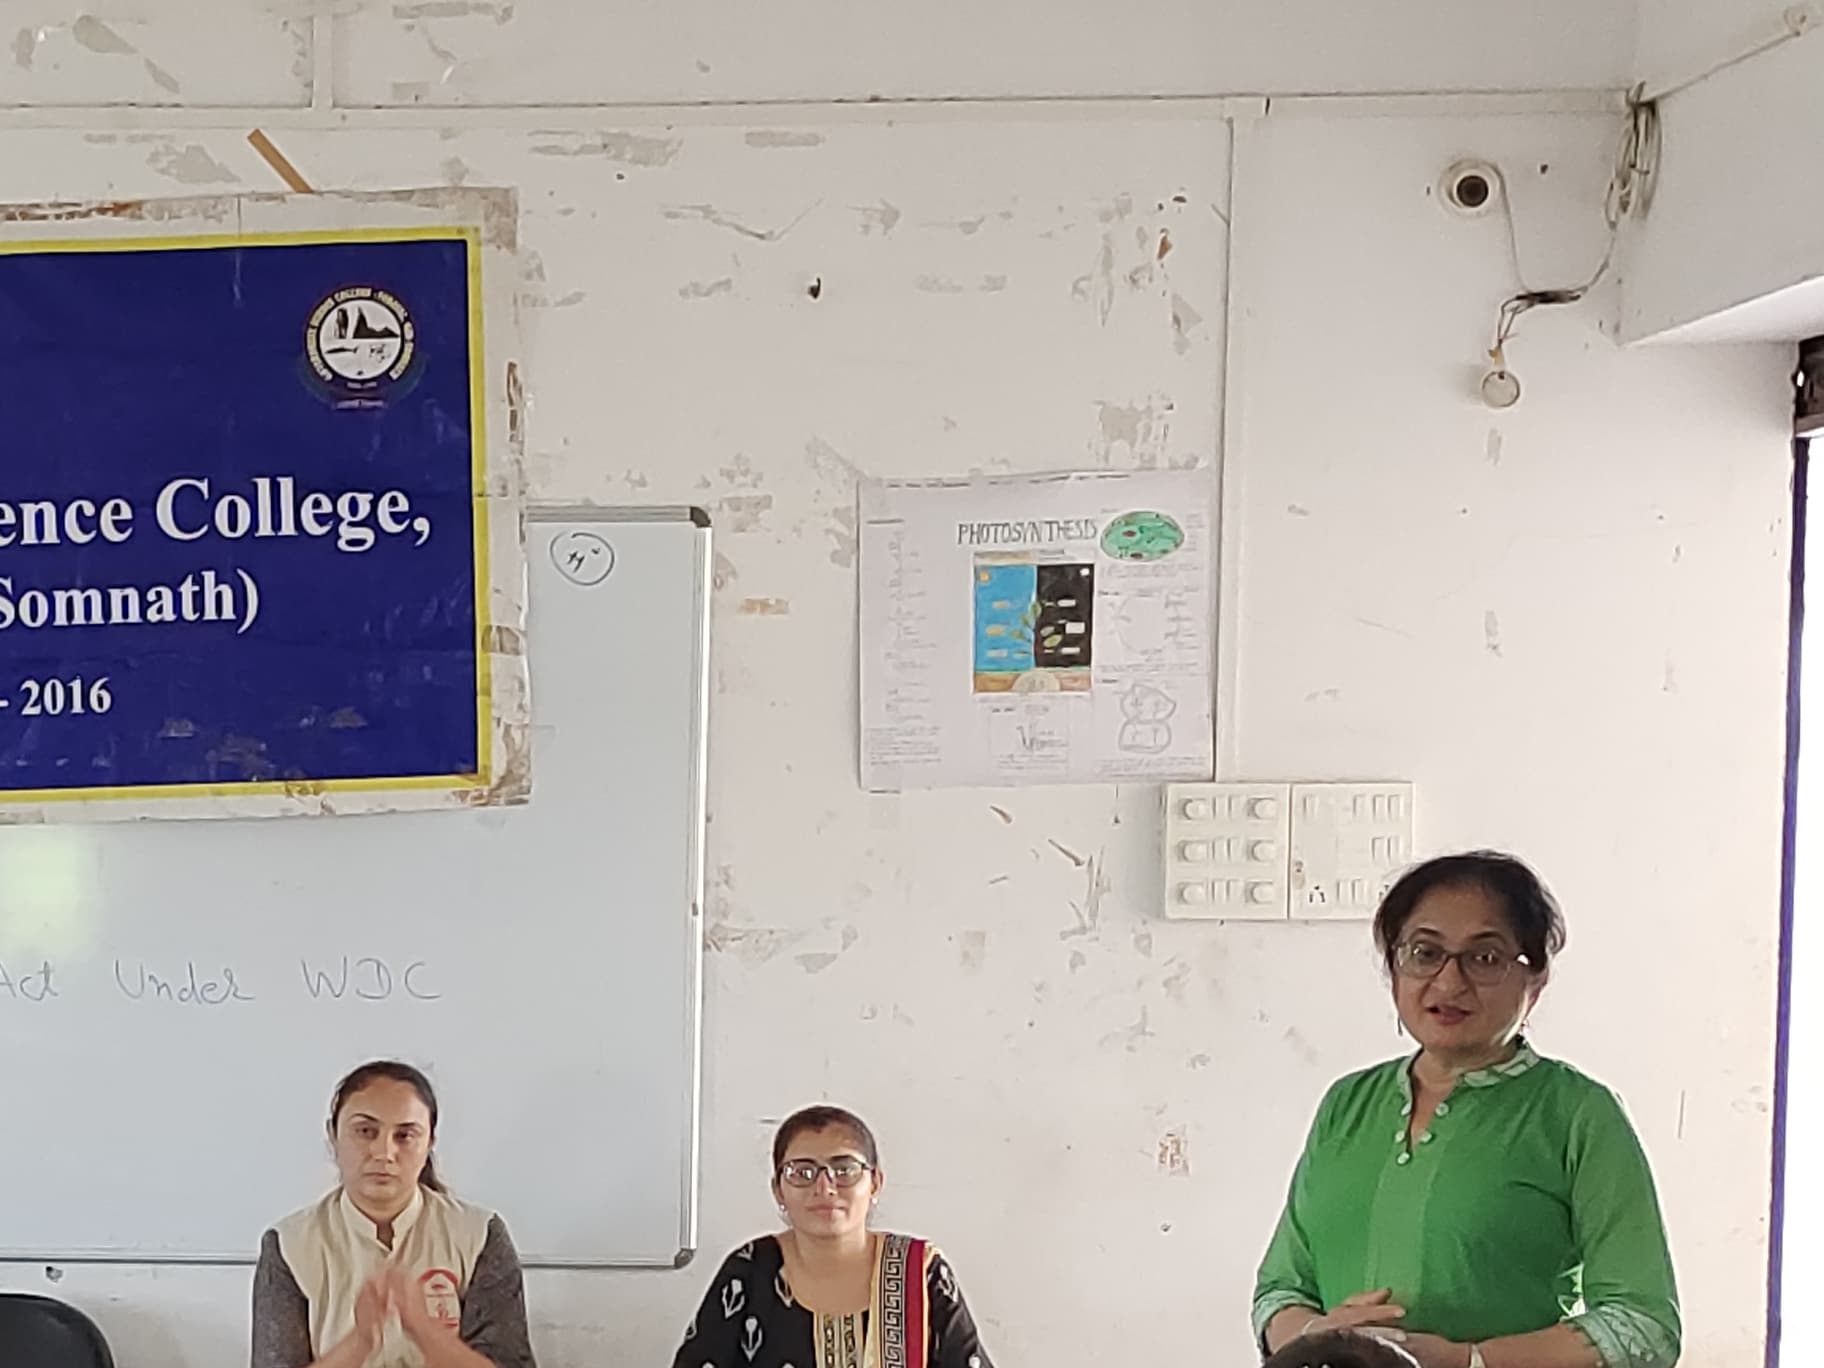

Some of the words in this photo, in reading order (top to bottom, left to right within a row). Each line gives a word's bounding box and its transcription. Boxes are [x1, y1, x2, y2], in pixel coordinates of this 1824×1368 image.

[155, 476, 431, 553] College,
[20, 676, 112, 716] 2016
[114, 958, 257, 1004] Under
[300, 955, 442, 1000] WDC
